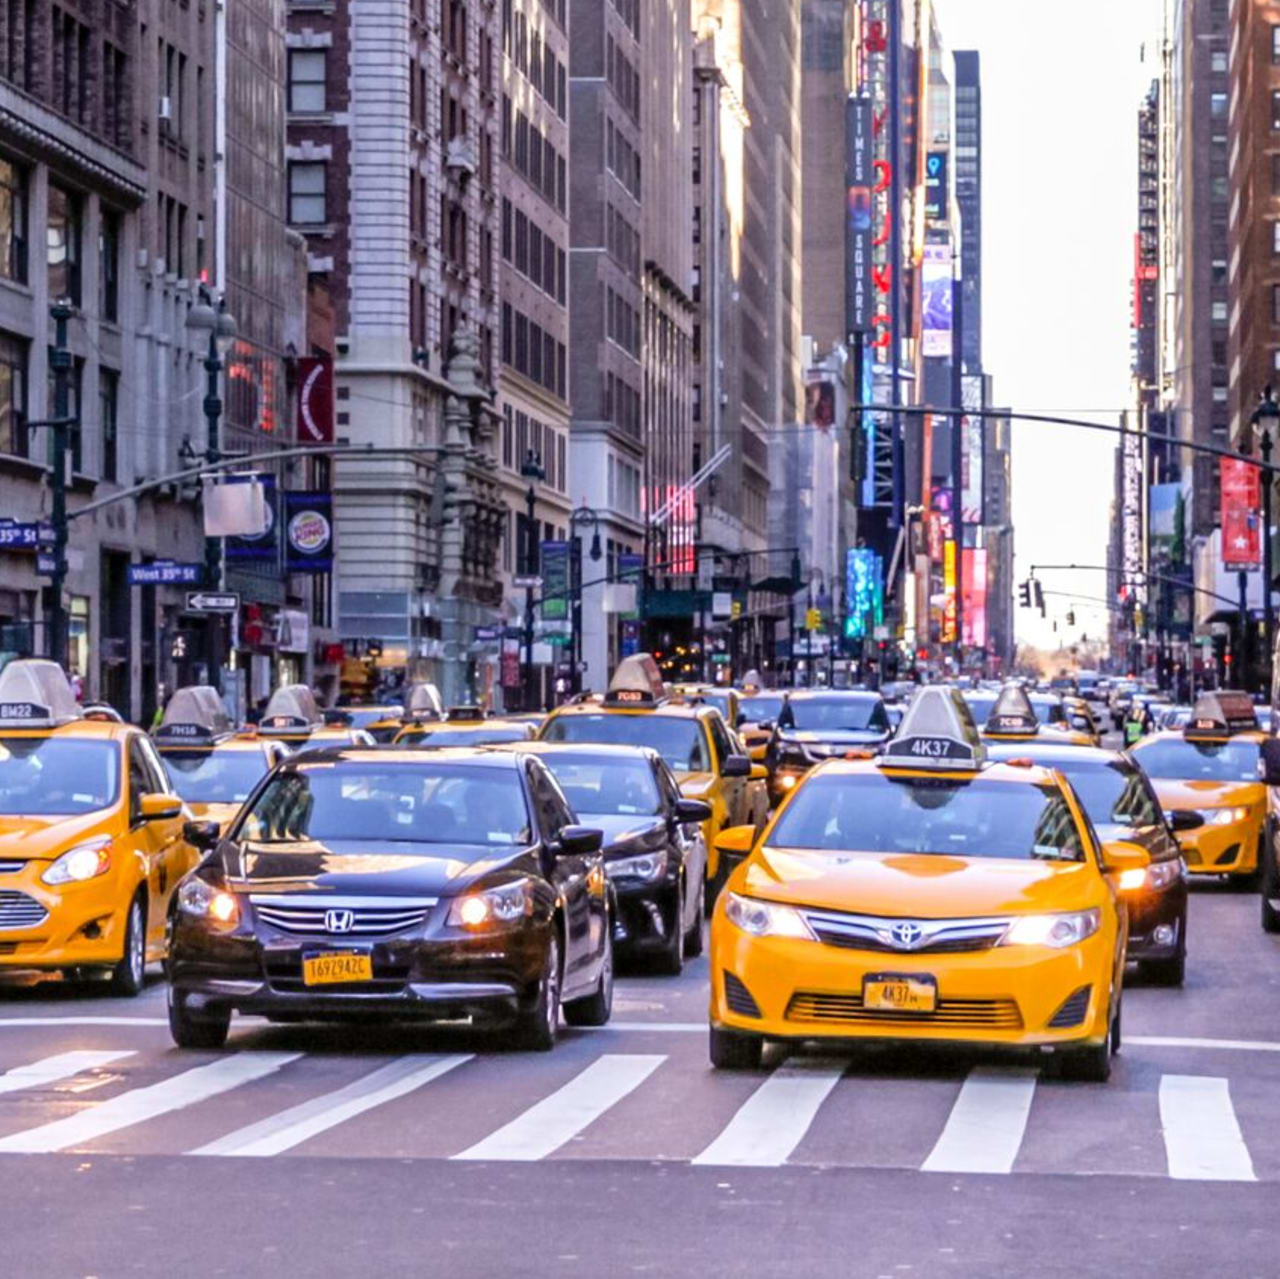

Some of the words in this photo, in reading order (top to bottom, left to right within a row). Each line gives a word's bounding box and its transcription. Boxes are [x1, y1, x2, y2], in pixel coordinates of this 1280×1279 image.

[855, 107, 865, 181] TIMES
[855, 234, 865, 324] SQUARE
[23, 529, 37, 543] St
[911, 740, 951, 756] 4K37
